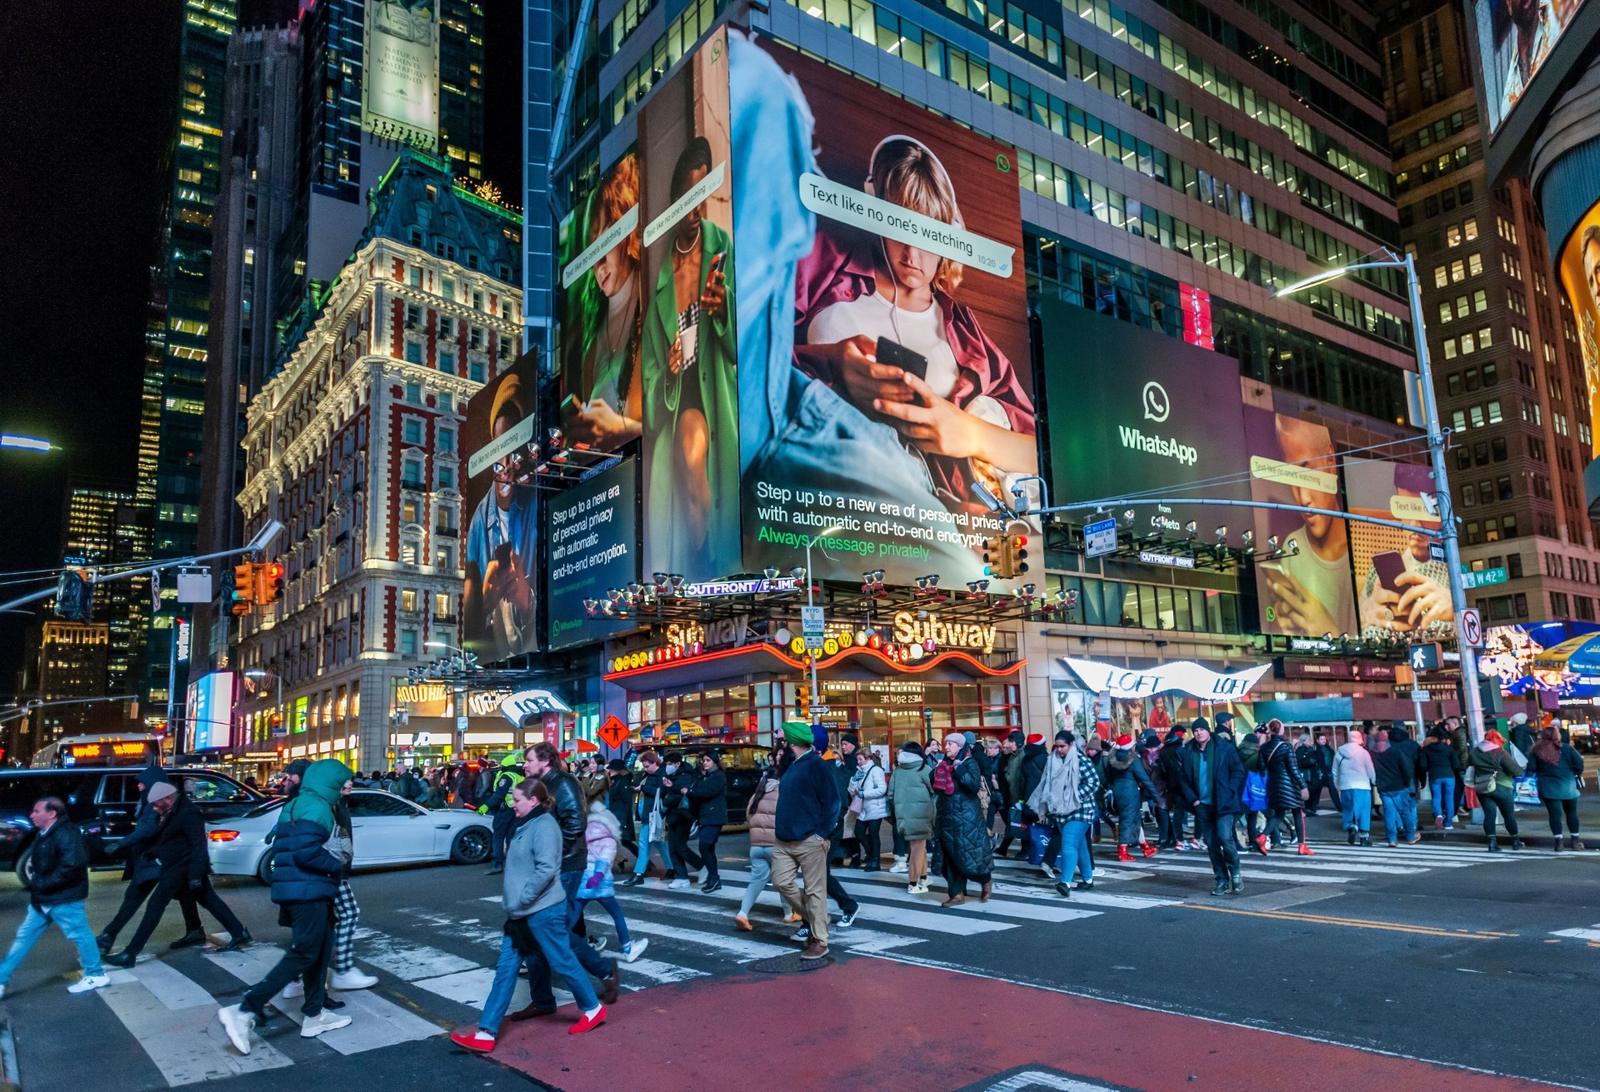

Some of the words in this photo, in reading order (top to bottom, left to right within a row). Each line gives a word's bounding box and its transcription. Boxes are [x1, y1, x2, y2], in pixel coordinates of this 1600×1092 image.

[684, 185, 706, 206] watching
[809, 183, 838, 206] Text
[841, 194, 864, 215] like
[867, 207, 884, 222] no
[887, 213, 919, 235] one's
[921, 226, 973, 257] watching
[1119, 425, 1197, 466] WhatsApp
[552, 510, 568, 525] Step
[568, 504, 578, 519] up
[578, 500, 586, 512] to
[586, 499, 592, 510] a
[592, 491, 607, 509] new
[608, 484, 620, 500] era
[757, 481, 791, 504] Step
[796, 490, 815, 507] up
[818, 491, 833, 506] to
[836, 497, 845, 509] a
[849, 498, 876, 513] new
[880, 502, 900, 517] era
[903, 504, 915, 518] of
[919, 508, 969, 526] personal
[1158, 504, 1172, 514] from
[1395, 501, 1409, 511] Text
[1410, 502, 1422, 511] like
[552, 528, 560, 543] of
[560, 517, 588, 543] personal
[589, 506, 614, 531] privacy
[757, 505, 788, 523] with
[793, 511, 861, 531] automatic
[864, 519, 934, 540] end-to-end
[937, 527, 993, 548] encrypti
[758, 526, 809, 549] Always
[814, 536, 875, 556] message
[552, 546, 566, 561] with
[566, 532, 599, 555] automatic
[552, 555, 588, 581] end-to-end
[589, 542, 628, 566] encryption.
[1476, 573, 1484, 584] W
[1485, 571, 1497, 583] 42
[894, 609, 996, 654] Subway
[1106, 671, 1164, 693] LOFT
[1212, 678, 1250, 694] LOFT
